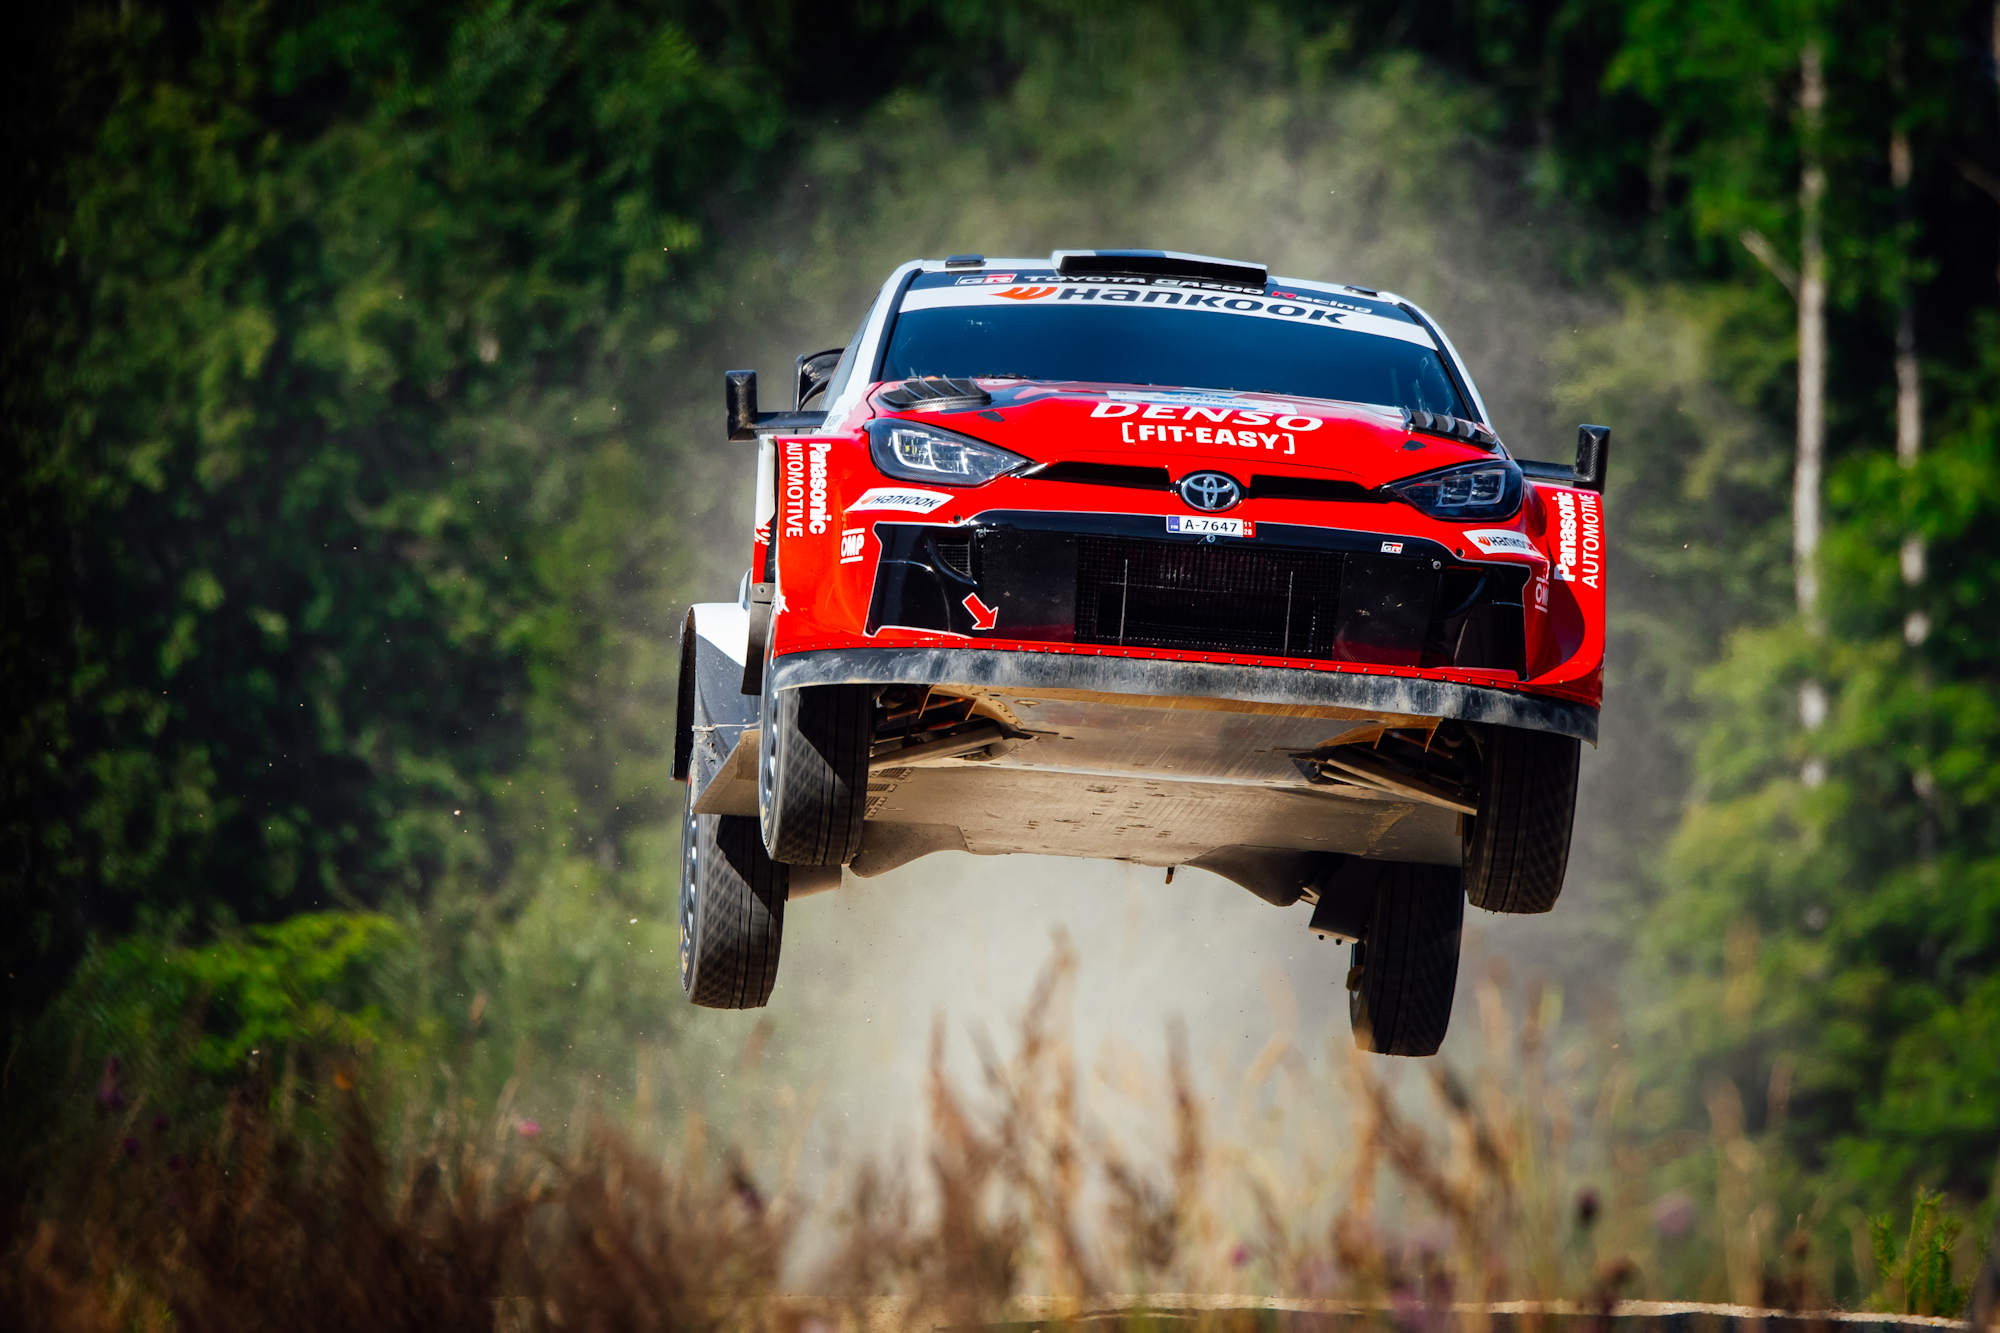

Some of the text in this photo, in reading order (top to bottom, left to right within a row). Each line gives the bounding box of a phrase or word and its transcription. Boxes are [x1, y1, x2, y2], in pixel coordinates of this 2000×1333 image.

[1024, 275, 1146, 284] TOYOTA
[1153, 279, 1265, 296] GAZOO
[1090, 401, 1324, 432] DENSO
[786, 441, 805, 538] AUTOMOTIVE
[808, 443, 832, 535] Panasonic
[840, 533, 865, 558] OMP
[1184, 519, 1238, 533] A-7647
[1552, 491, 1577, 583] Panasonic
[1578, 493, 1600, 589] AUTOMOTIVE
